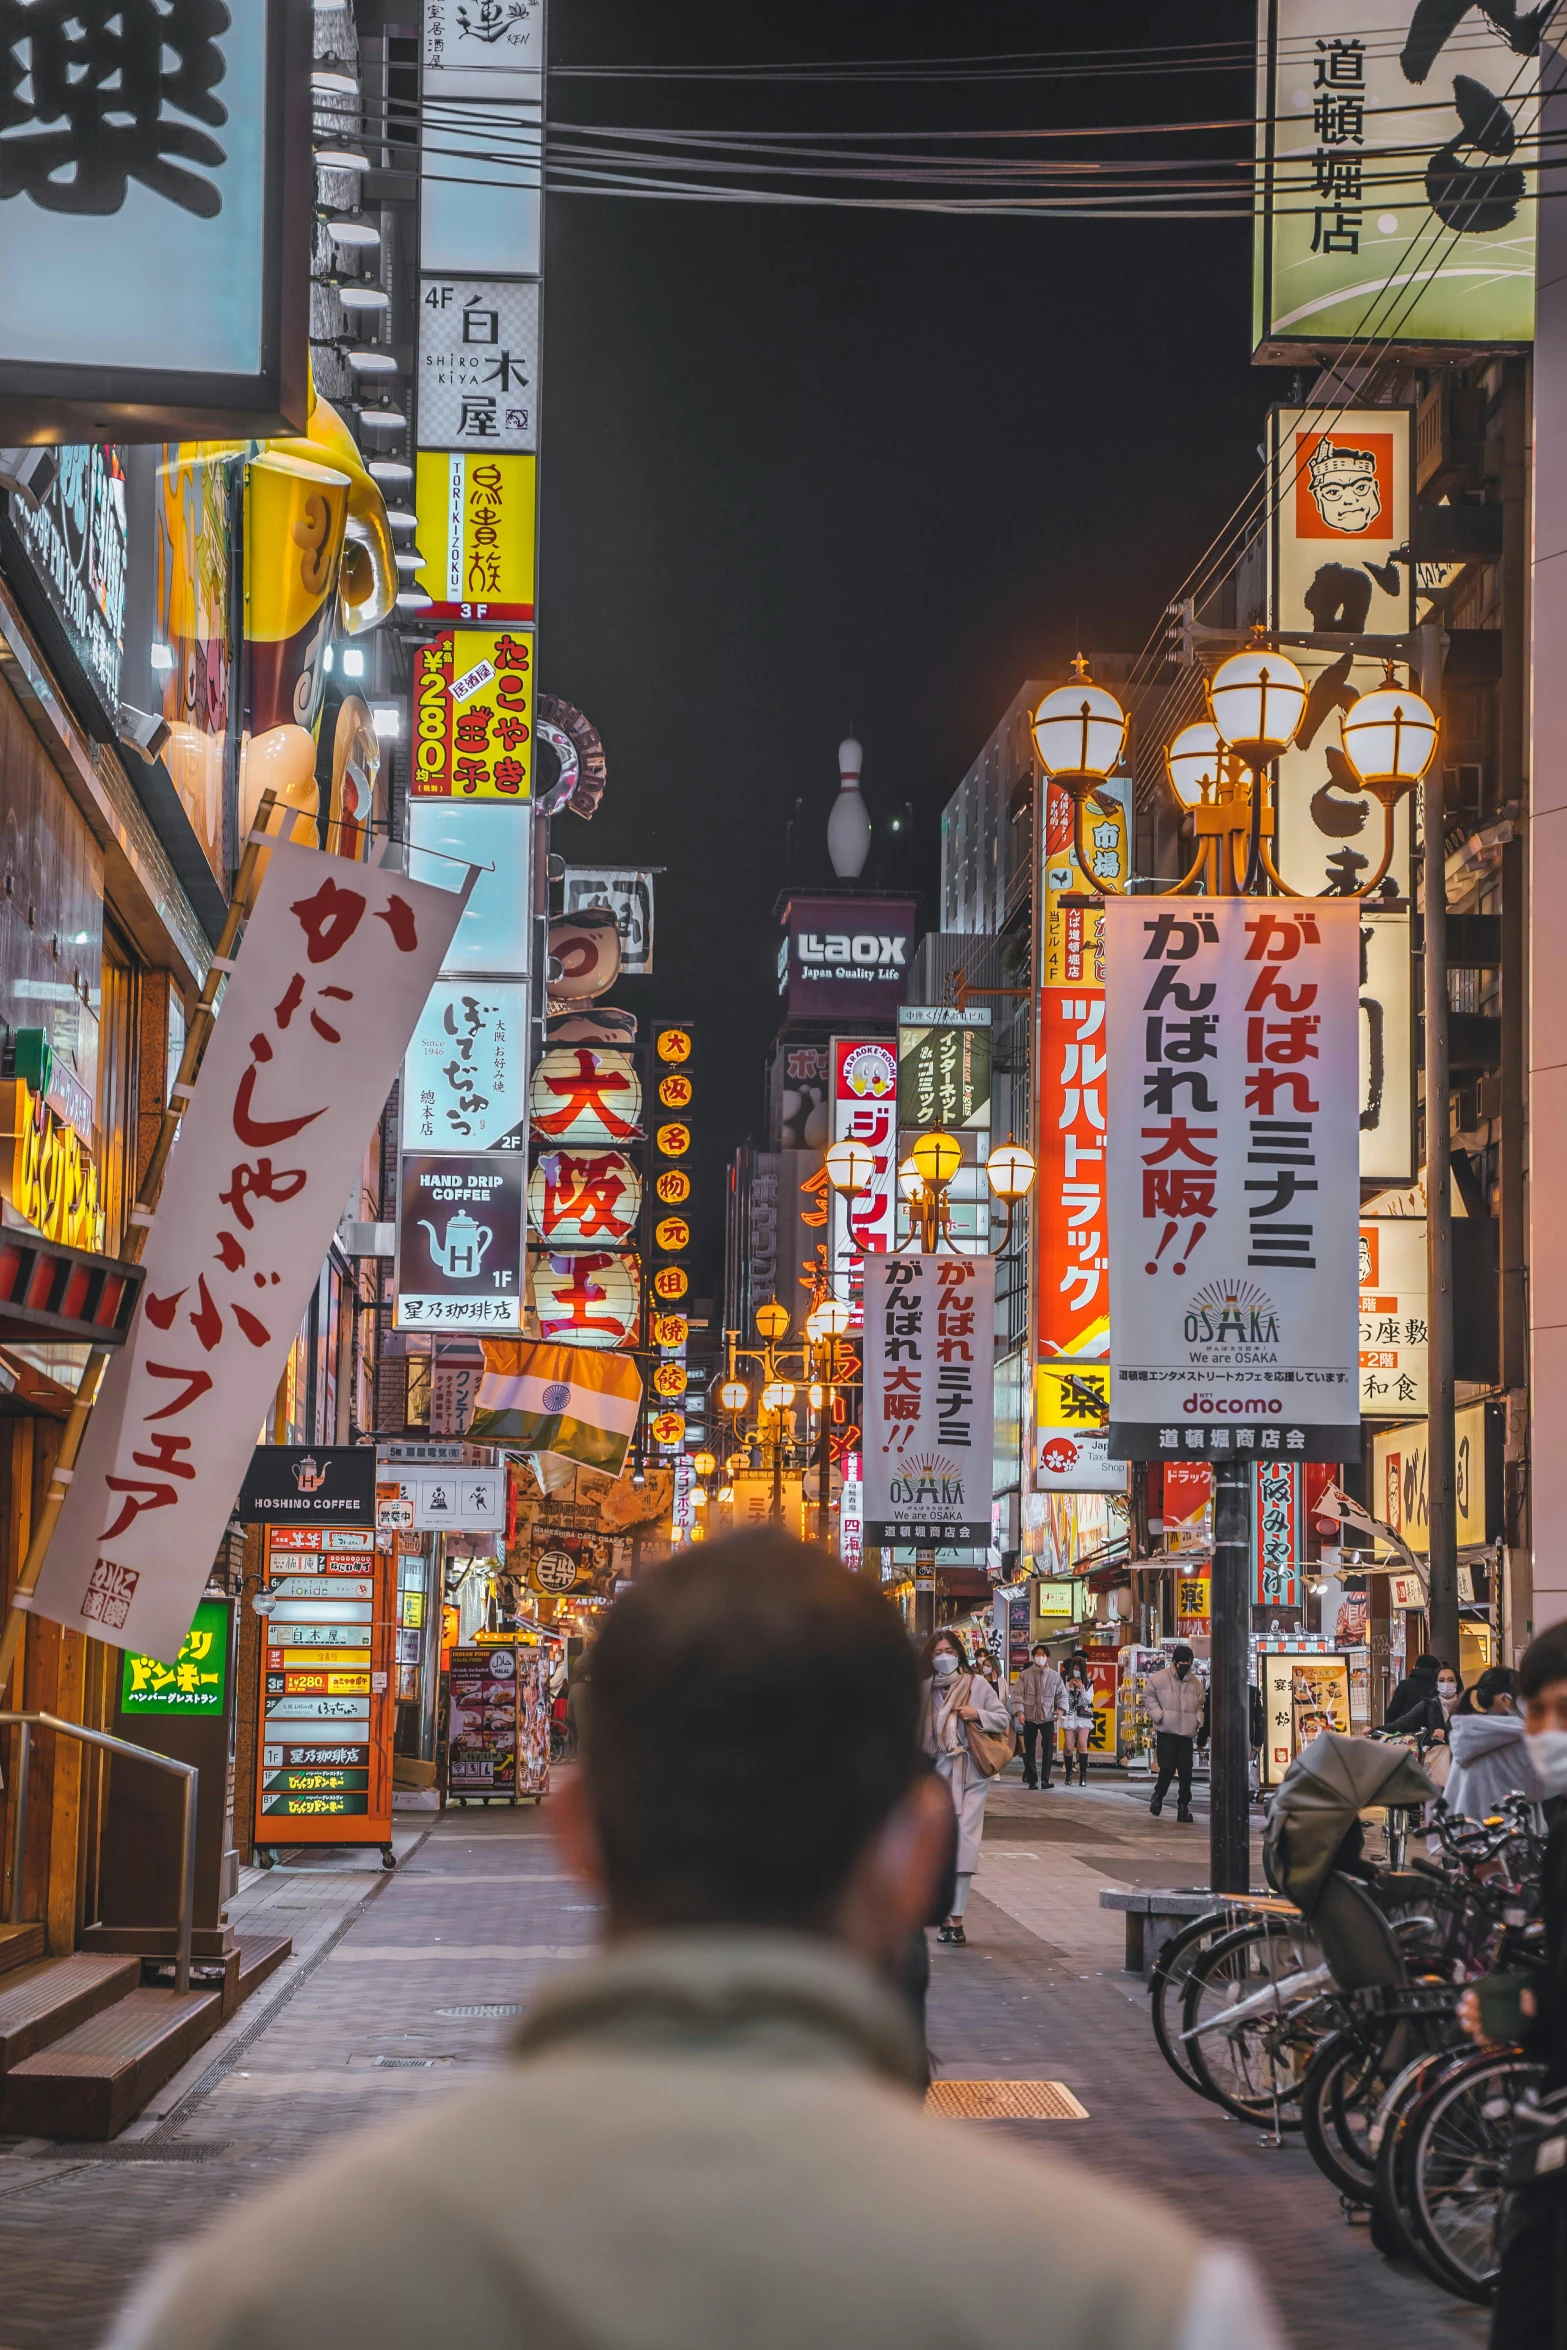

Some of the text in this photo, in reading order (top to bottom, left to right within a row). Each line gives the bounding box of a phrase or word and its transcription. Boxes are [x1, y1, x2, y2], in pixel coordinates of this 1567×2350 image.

[427, 0, 445, 69] 室居酒屋
[506, 33, 530, 45] REN
[1310, 38, 1367, 256] 道頓堀店
[424, 286, 454, 309] 4F
[456, 294, 530, 437] 白木屋
[460, 603, 488, 619] 3F
[452, 663, 494, 700] 居酒屋
[493, 634, 530, 795] たこやき
[1093, 821, 1120, 878] 市場
[1067, 908, 1081, 978] んば道頓堀店
[801, 965, 900, 981] Japan Quality Life
[421, 1038, 445, 1048] Since
[902, 1030, 918, 1047] 2F
[424, 1048, 445, 1056] 1946
[939, 1030, 957, 1125] インターネット
[1244, 912, 1321, 1270] がんばれミナミ
[501, 1135, 522, 1149] 2F
[1058, 999, 1109, 1312] ツルハドラッグ
[420, 1175, 504, 1188] HAND DRIP
[432, 1188, 491, 1202] COFFEE
[96, 876, 419, 1542] かにしゃぶフェア
[492, 1271, 513, 1288] 1F
[403, 1299, 514, 1322] 星乃珈琲店
[1360, 1297, 1377, 1312] 階
[936, 1261, 976, 1447] がんばれミナミ
[1189, 1352, 1278, 1364] We are OSAKA
[1363, 1373, 1418, 1401] 和食
[1183, 1392, 1283, 1414] docomo
[1159, 1428, 1306, 1450] 道頓堀商店会
[1101, 1461, 1125, 1473] Shop
[254, 1498, 361, 1510] HOSHINO COFFEE
[894, 1510, 963, 1521] We are OSAKA
[534, 1526, 576, 1538] MAMESHIBA
[577, 1533, 597, 1541] CAFE
[884, 1525, 971, 1538] 道頓堀商店会
[270, 1578, 281, 1588] 6F
[1181, 1582, 1204, 1614] 薬
[293, 1628, 339, 1641] 白木屋
[129, 1656, 219, 1693] ドンキー
[268, 1677, 284, 1690] 3F
[128, 1692, 218, 1704] ハンバーグレストラン
[266, 1700, 277, 1708] 2F
[267, 1750, 279, 1763] 1F
[289, 1747, 360, 1764] 星乃珈琲店
[264, 1772, 273, 1780] 1F
[263, 1796, 273, 1804] B1
